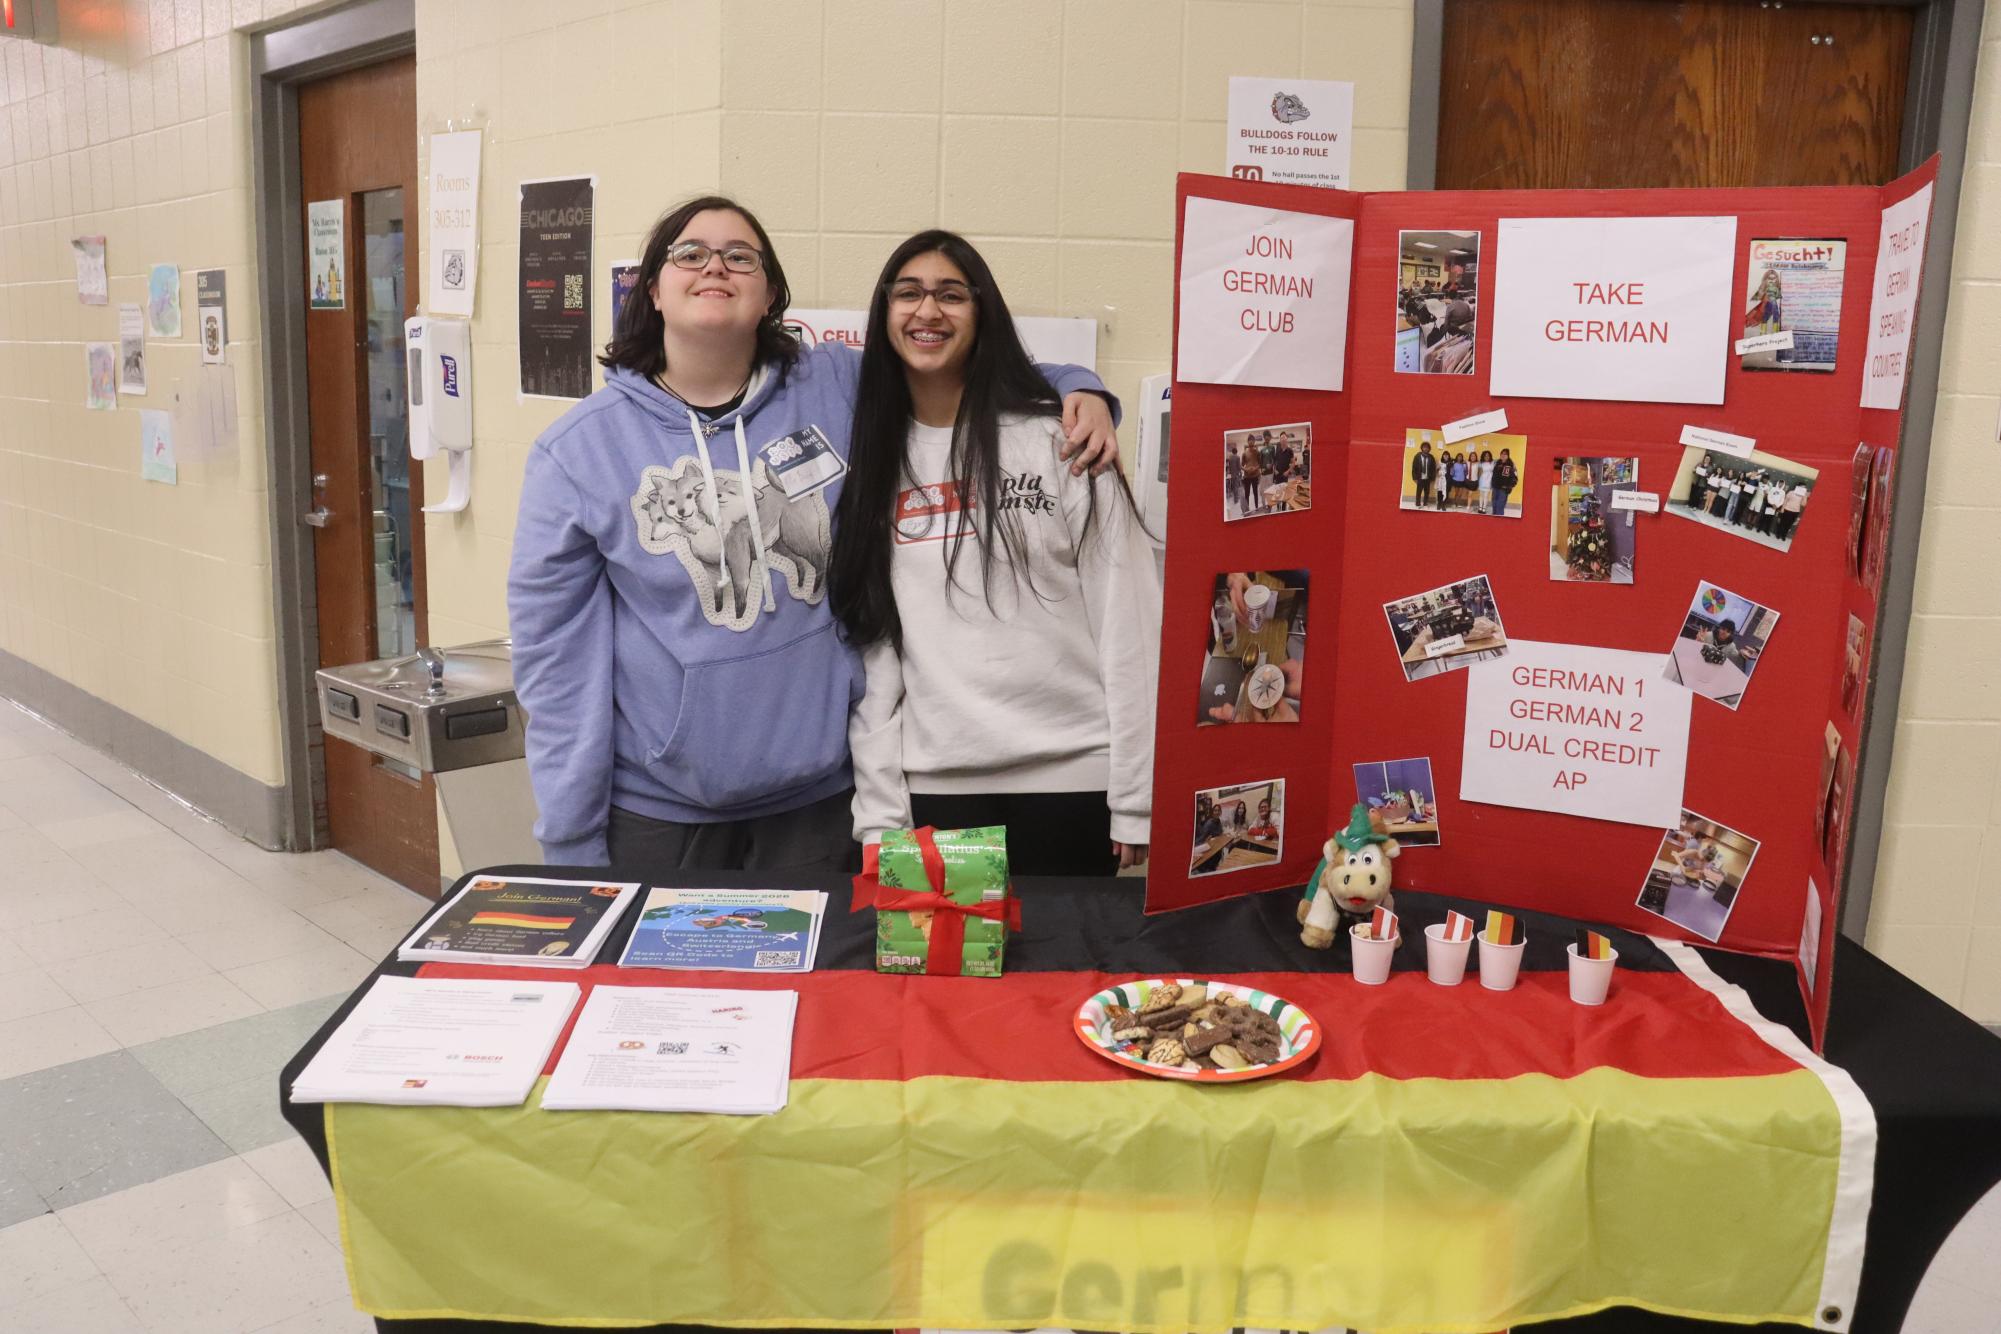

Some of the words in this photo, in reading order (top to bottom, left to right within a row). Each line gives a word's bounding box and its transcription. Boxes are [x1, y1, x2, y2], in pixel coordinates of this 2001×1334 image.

[1240, 128, 1294, 140] BULLDOGS
[1297, 131, 1338, 142] FOLLOW
[1248, 144, 1268, 154] THE
[1271, 146, 1300, 156] 10-10
[1302, 147, 1329, 157] RULE
[436, 173, 470, 192] Rooms
[433, 208, 471, 229] 305-312
[528, 207, 585, 229] CHICAGO
[1245, 234, 1293, 260] JOIN
[1753, 242, 1834, 262] Gesucht!
[1223, 269, 1313, 299] GERMAN
[1573, 283, 1645, 305] TAKE
[1240, 308, 1294, 333] CLUB
[1545, 320, 1668, 343] GERMAN
[444, 359, 456, 393] Purell
[1512, 666, 1624, 695] GERMAN
[1634, 678, 1644, 698] 1
[1510, 699, 1621, 729] GERMAN
[1629, 712, 1644, 732] 2
[1489, 729, 1555, 755] DUAL
[1564, 738, 1661, 767] CREDIT
[1553, 770, 1587, 791] AP
[496, 892, 524, 900] Join
[527, 894, 583, 903] German!
